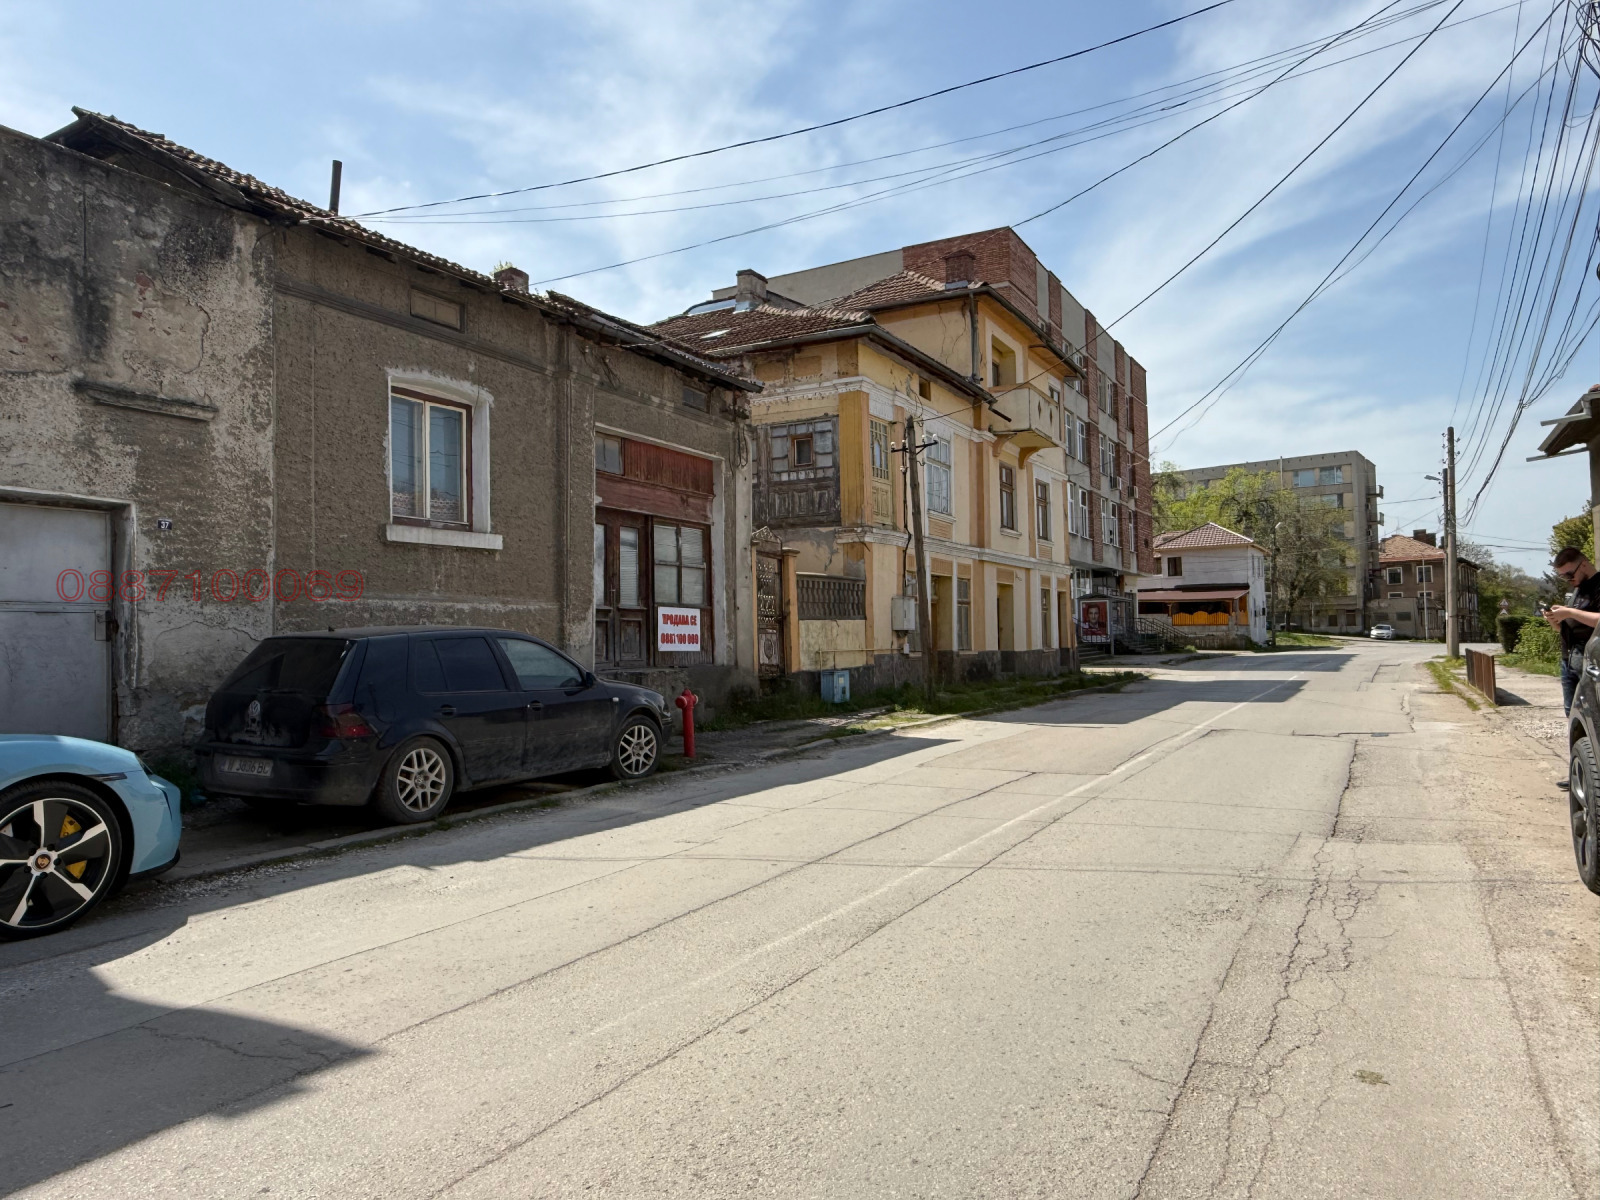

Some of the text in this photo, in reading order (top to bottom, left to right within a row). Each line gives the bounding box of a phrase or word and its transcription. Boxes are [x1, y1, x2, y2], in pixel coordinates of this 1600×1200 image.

[160, 521, 170, 529] 37
[662, 614, 697, 627] ПРОДАВА СЕ
